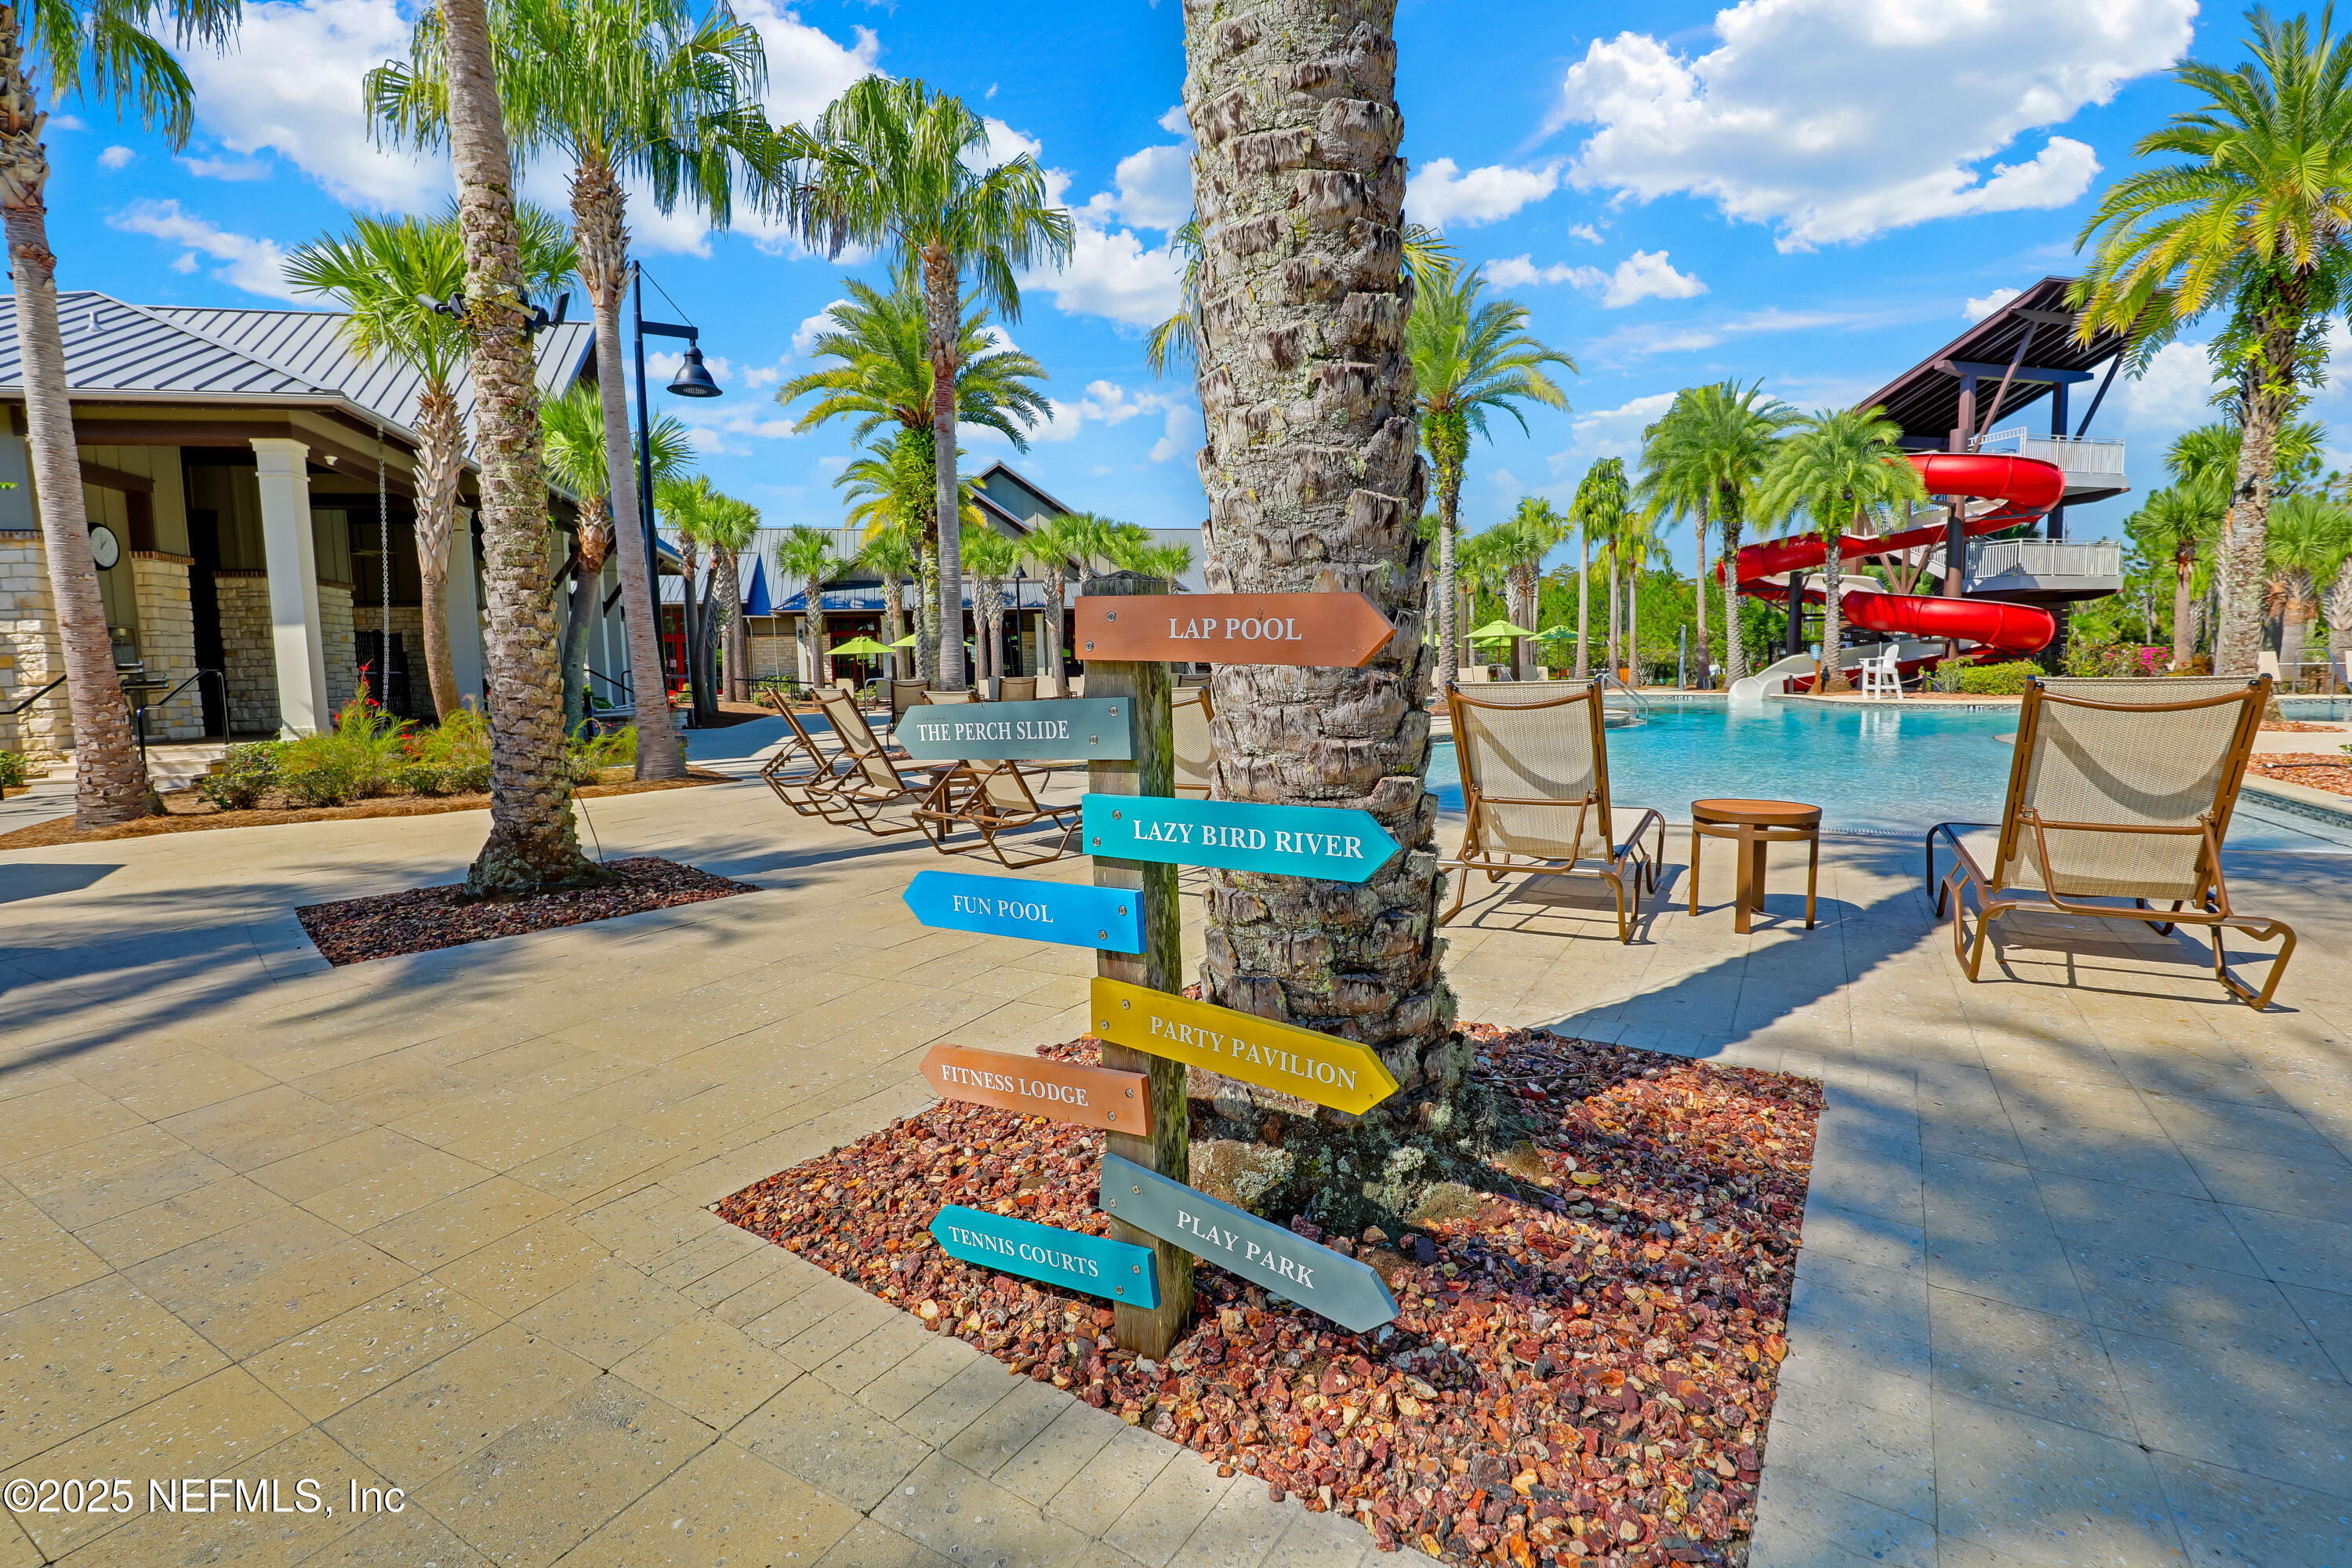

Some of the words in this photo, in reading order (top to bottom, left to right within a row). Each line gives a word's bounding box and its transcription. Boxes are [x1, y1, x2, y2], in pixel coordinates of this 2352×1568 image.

[1168, 618, 1218, 639] LAP
[1224, 618, 1302, 641] POOL
[916, 723, 951, 742] THE
[953, 721, 1012, 741] PERCH
[1016, 720, 1070, 740] SLIDE
[1133, 819, 1194, 844] LAZY
[1201, 825, 1266, 851] BIRD
[1274, 830, 1364, 859] RIVER
[953, 895, 992, 916] FUN
[996, 899, 1054, 924] POOL
[1149, 1015, 1225, 1053] PARTY
[1231, 1037, 1357, 1091] PAVILION
[940, 1064, 1014, 1093] FITNESS
[1018, 1078, 1089, 1107] LODGE
[948, 1225, 1015, 1257] TENNIS
[1018, 1243, 1099, 1277] COURTS
[1176, 1209, 1240, 1253] PLAY
[1244, 1240, 1315, 1290] PARK
